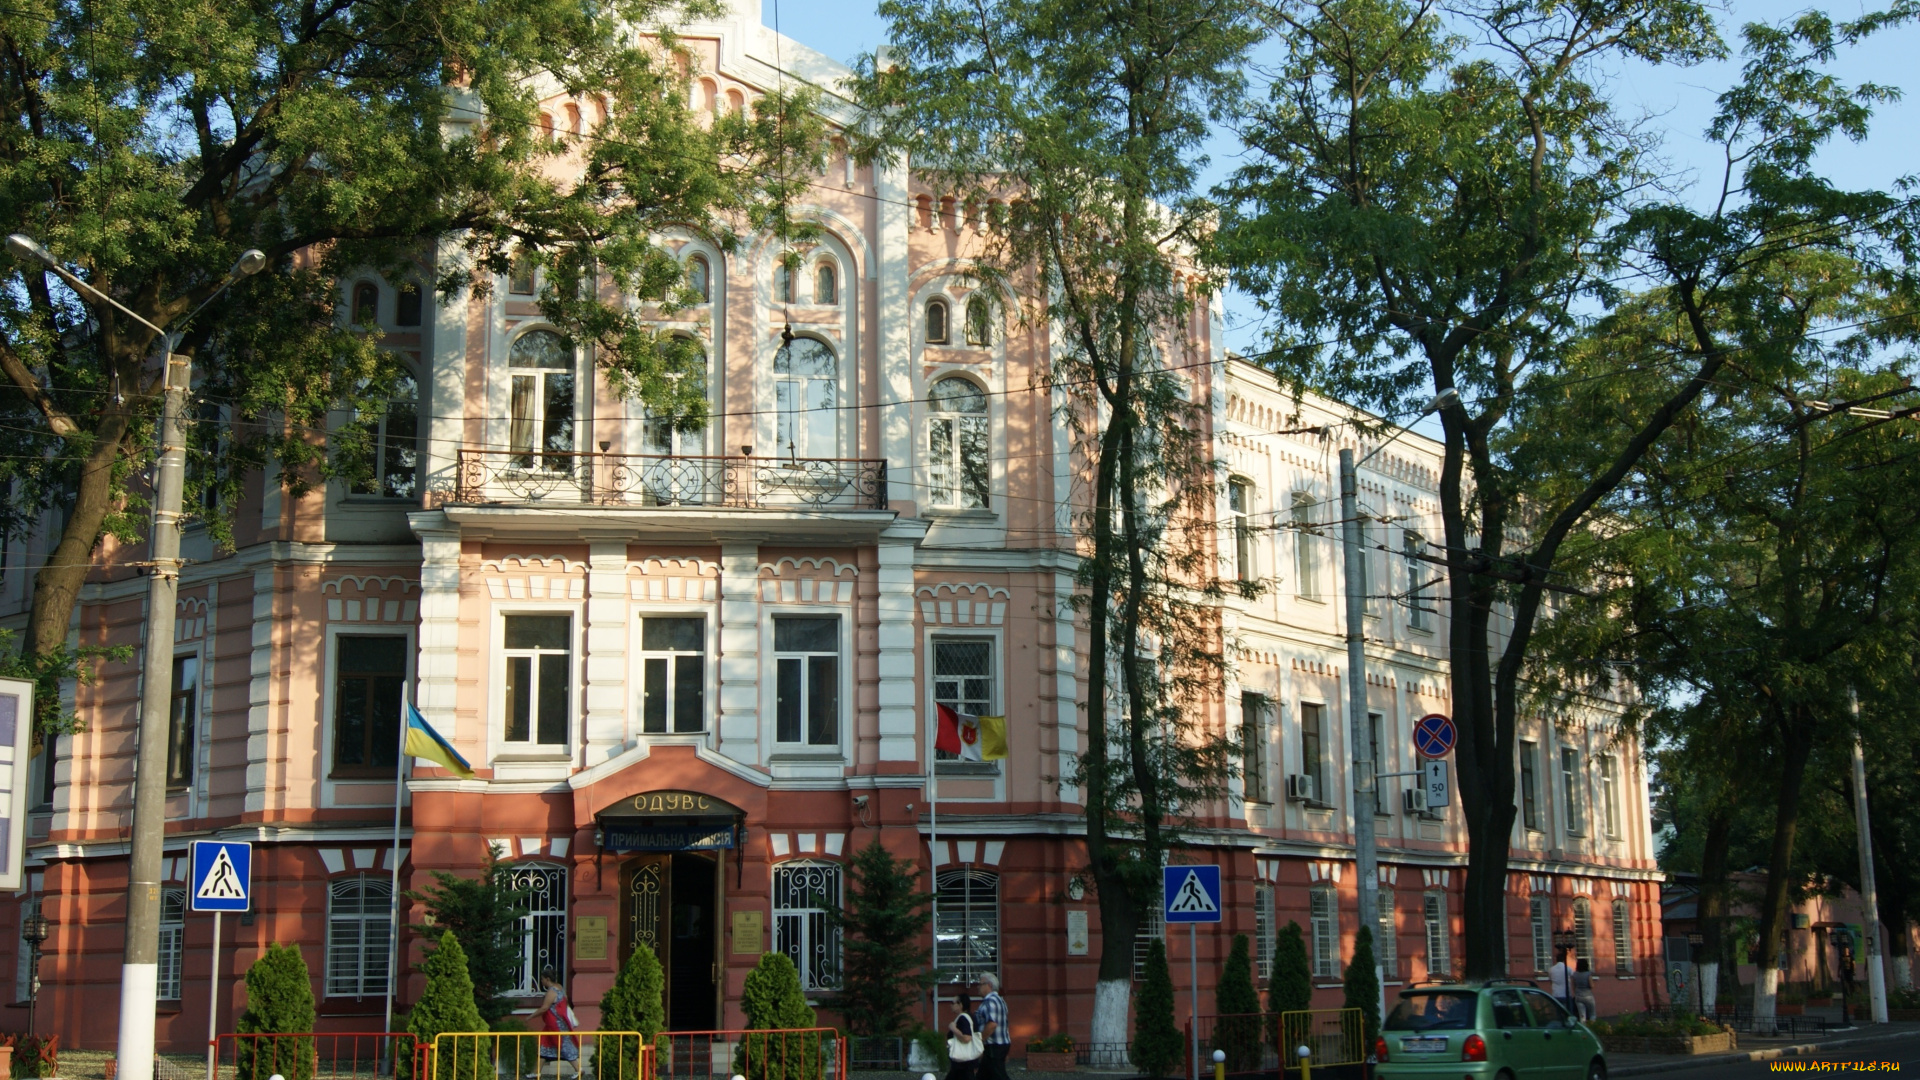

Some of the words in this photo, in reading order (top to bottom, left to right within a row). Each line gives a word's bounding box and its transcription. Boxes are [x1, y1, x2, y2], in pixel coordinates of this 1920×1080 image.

[1432, 783, 1444, 792] 50
[634, 795, 710, 811] ОДУВС
[611, 831, 685, 846] ПРИЙМАЛЬНА
[688, 831, 732, 846] КОМІСІЯ
